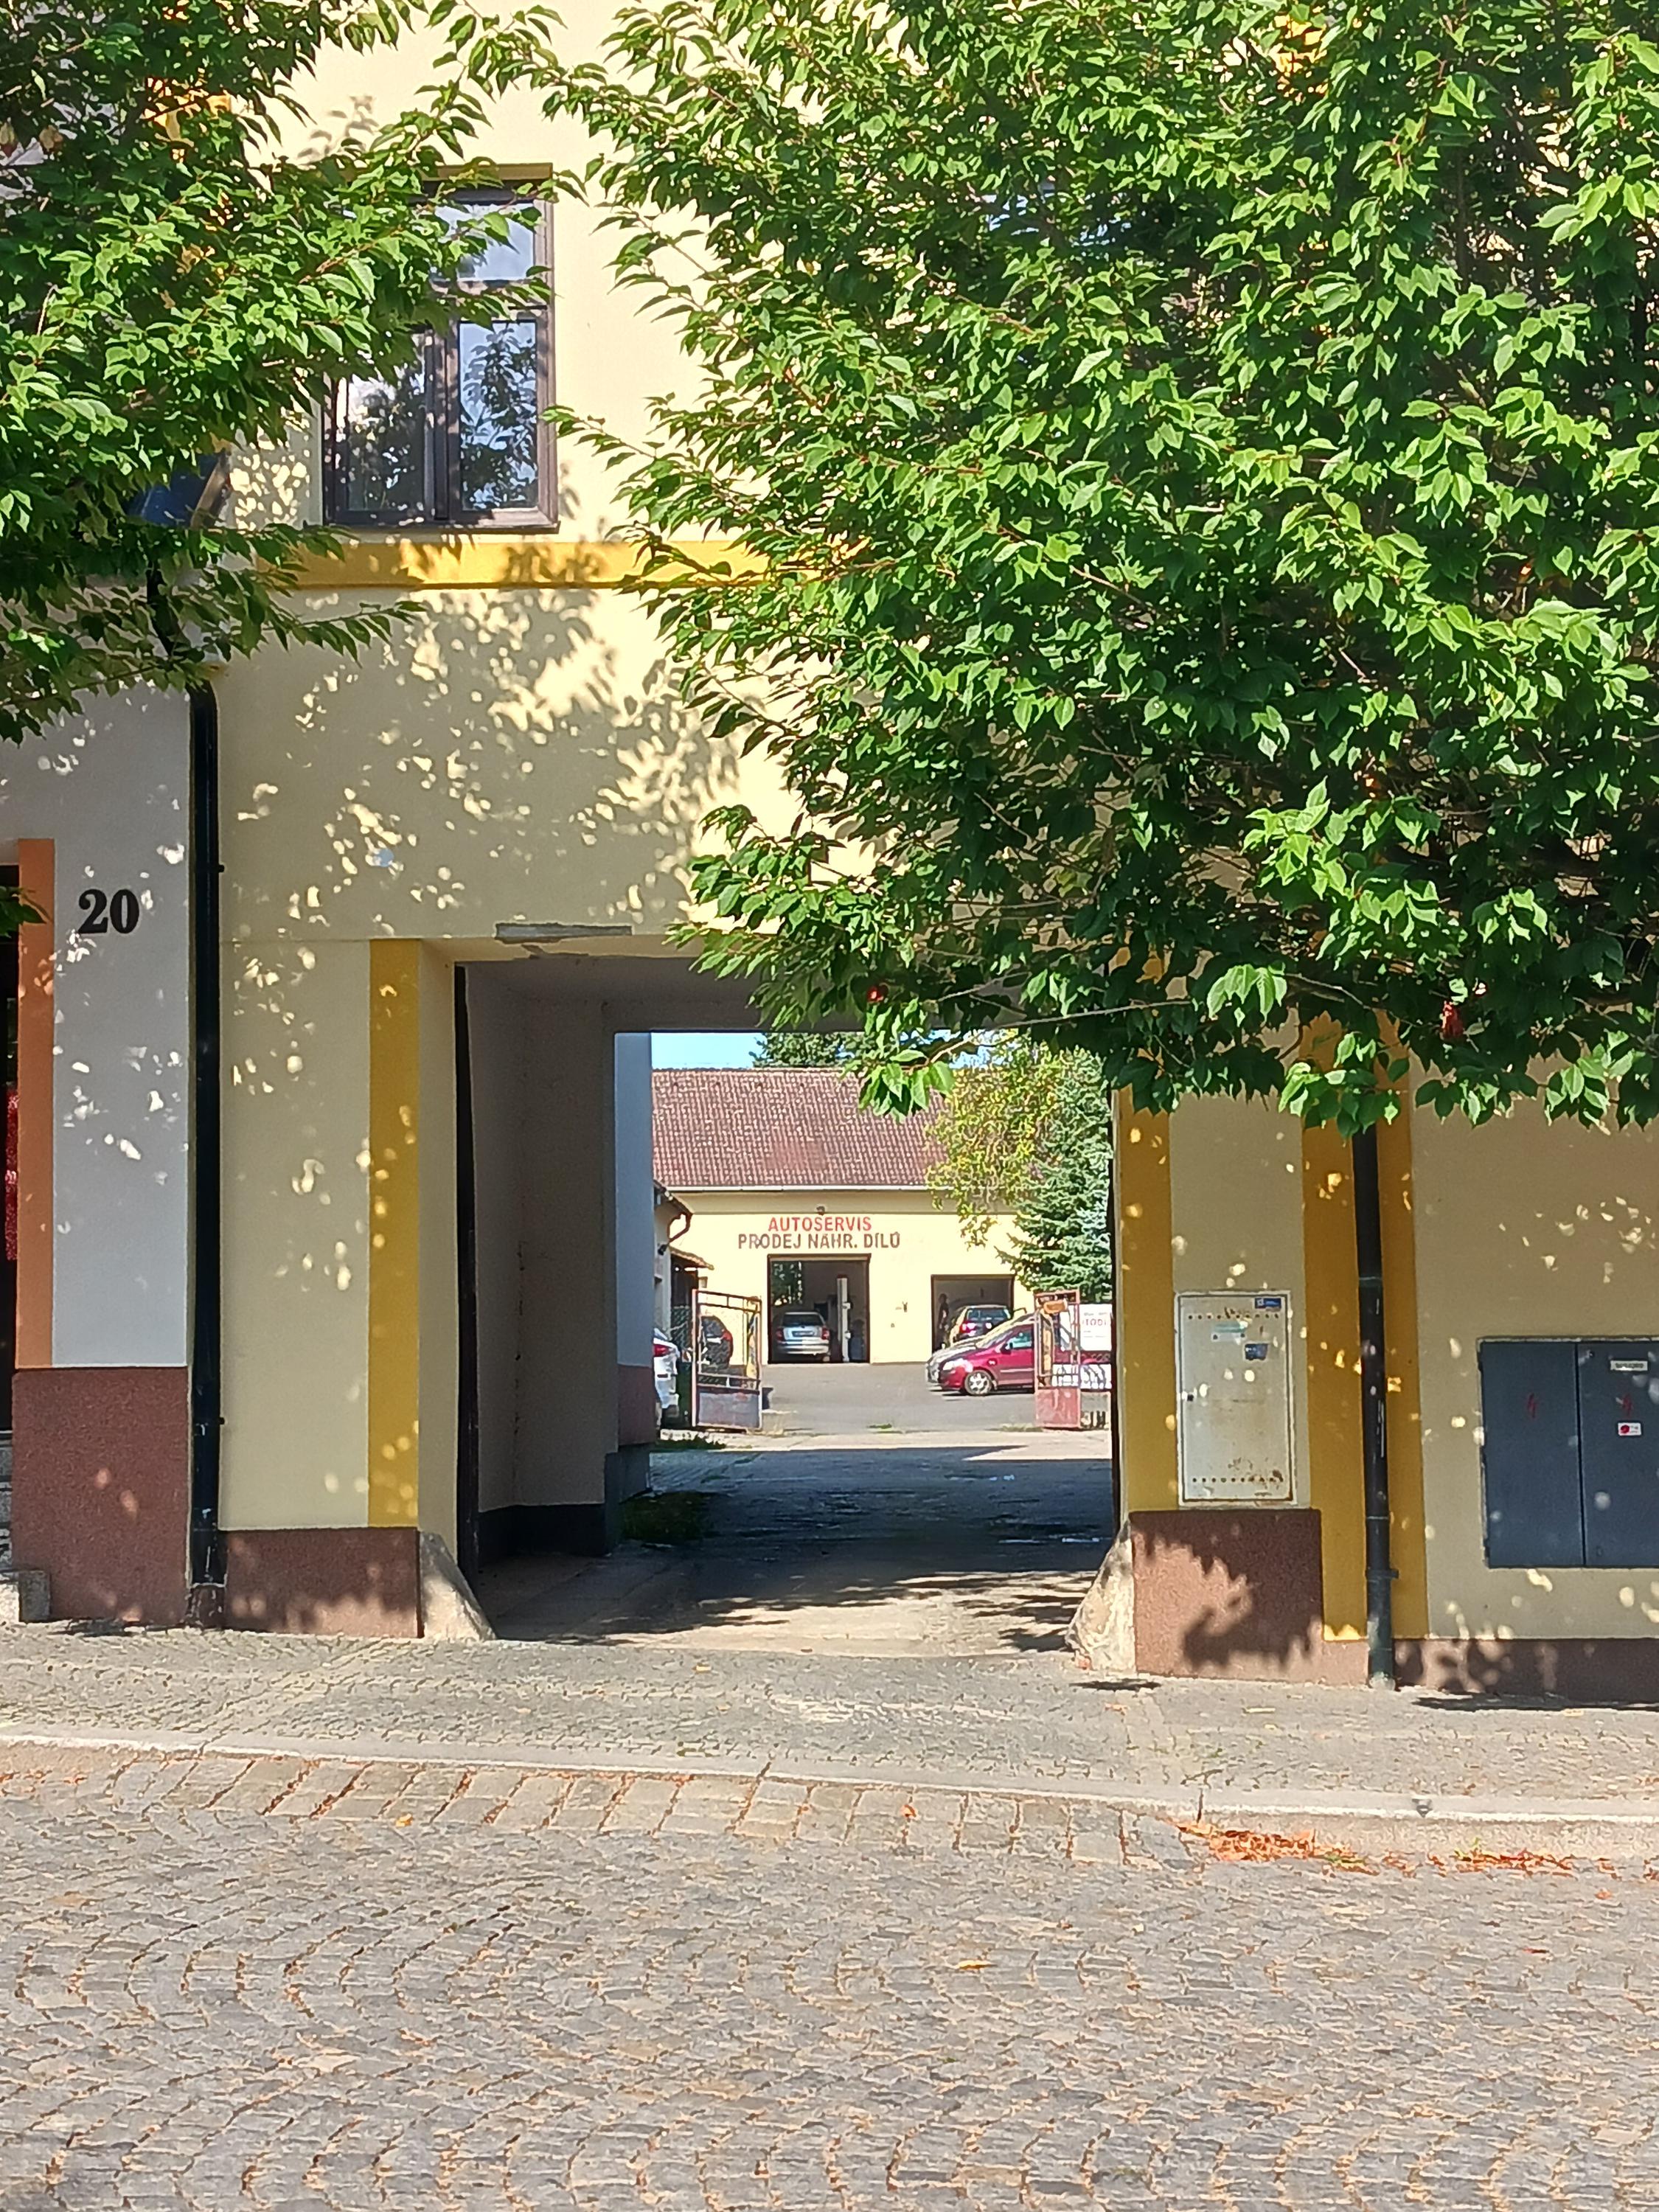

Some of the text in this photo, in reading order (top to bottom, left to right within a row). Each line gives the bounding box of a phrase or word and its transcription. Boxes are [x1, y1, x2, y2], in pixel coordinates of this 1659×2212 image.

[77, 888, 140, 934] 20
[768, 1217, 872, 1231] AUTOSERVIS
[738, 1234, 801, 1249] PRODEJ
